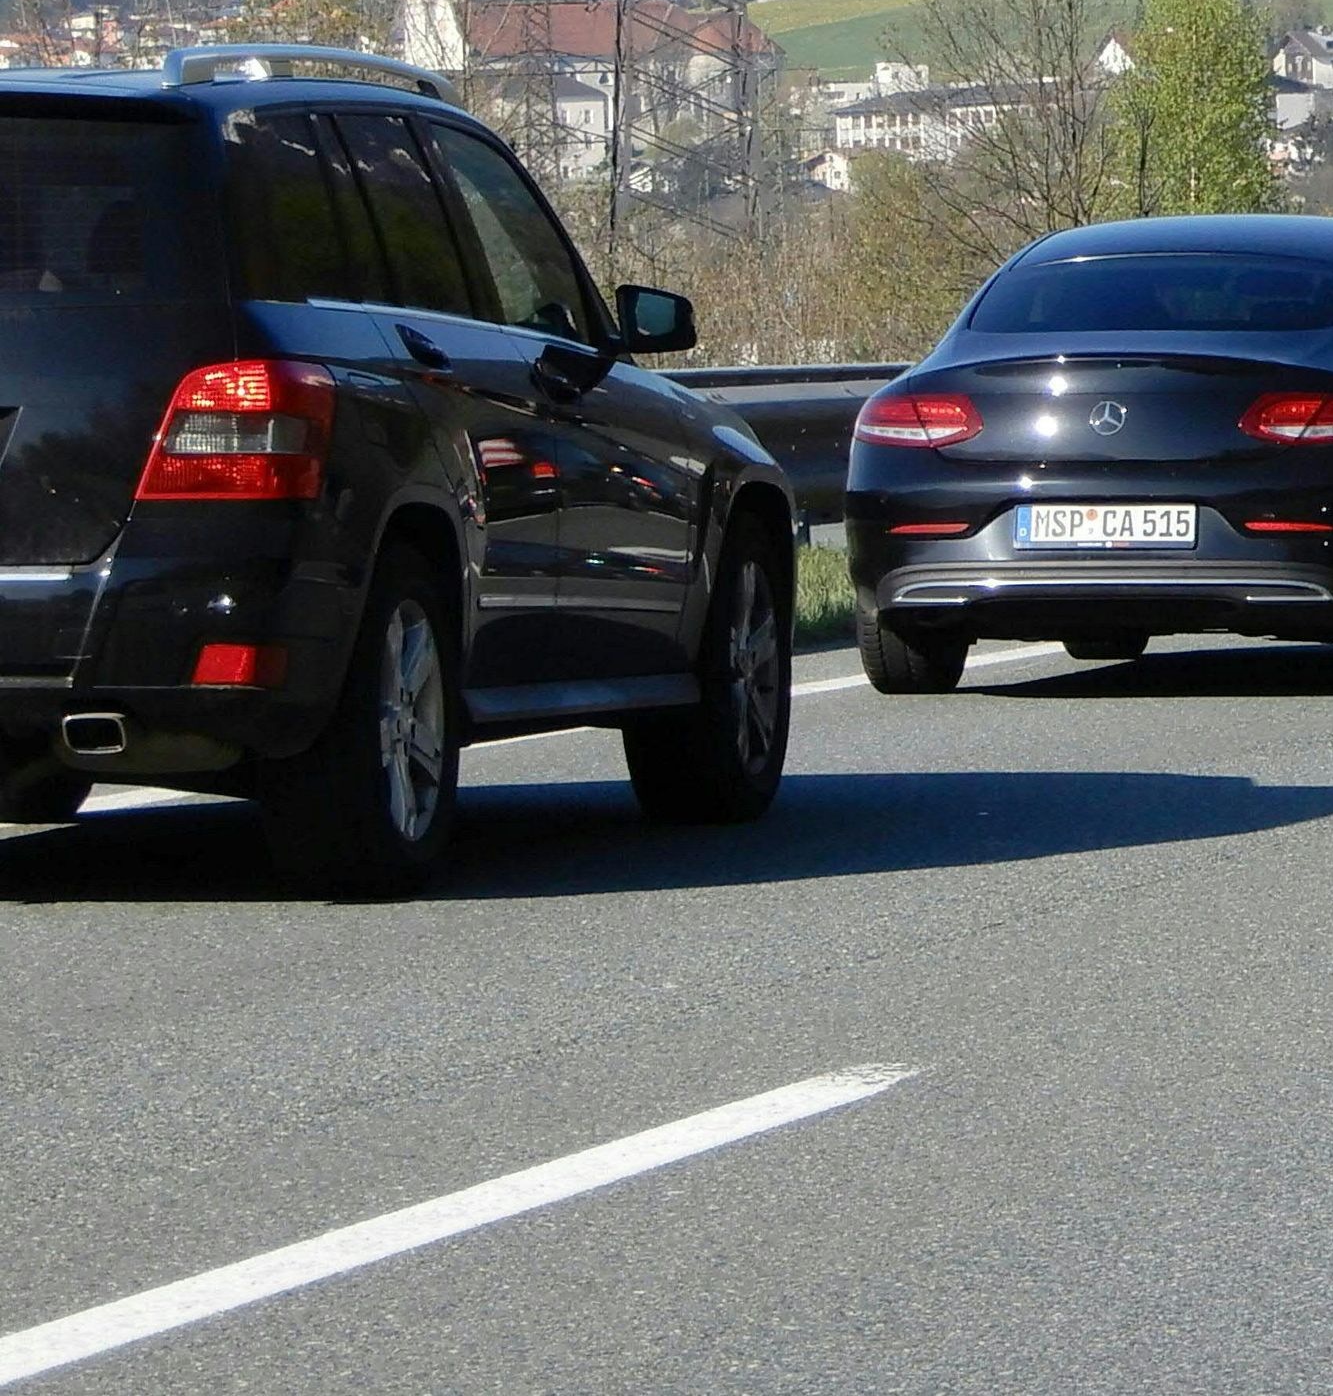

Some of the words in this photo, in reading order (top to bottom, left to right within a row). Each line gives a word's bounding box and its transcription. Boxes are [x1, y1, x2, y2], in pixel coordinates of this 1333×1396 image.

[1034, 509, 1084, 538] MSP
[1102, 509, 1134, 537] CA
[1142, 509, 1191, 538] 515
